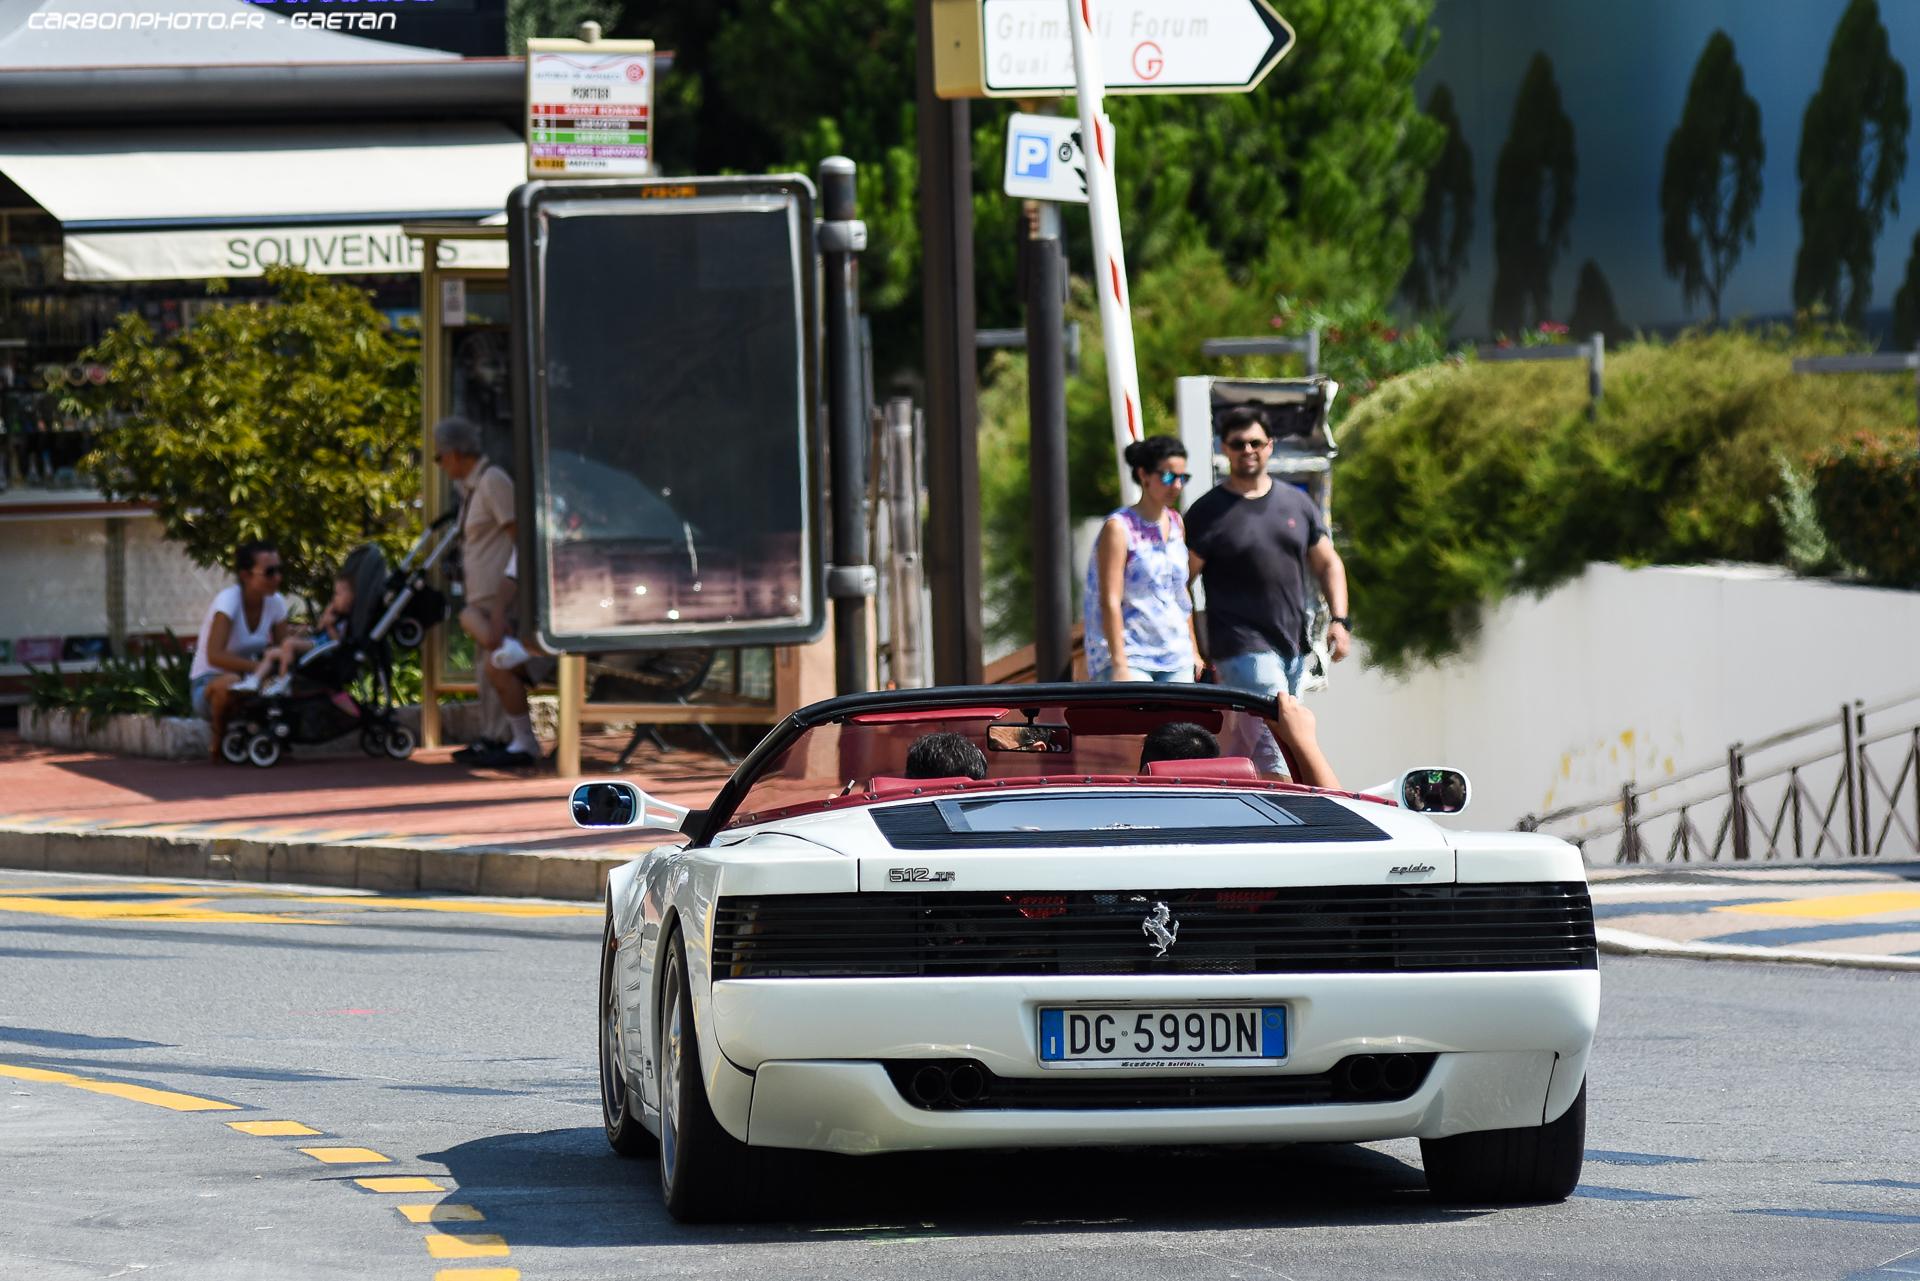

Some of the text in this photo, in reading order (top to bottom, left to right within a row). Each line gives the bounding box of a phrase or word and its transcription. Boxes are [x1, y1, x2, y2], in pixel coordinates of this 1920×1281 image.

[998, 11, 1209, 41] Grimli Forum
[1132, 41, 1164, 80] G
[1016, 136, 1049, 175] P
[889, 867, 956, 882] 512 TR
[1069, 1012, 1258, 1055] DG 599DN
